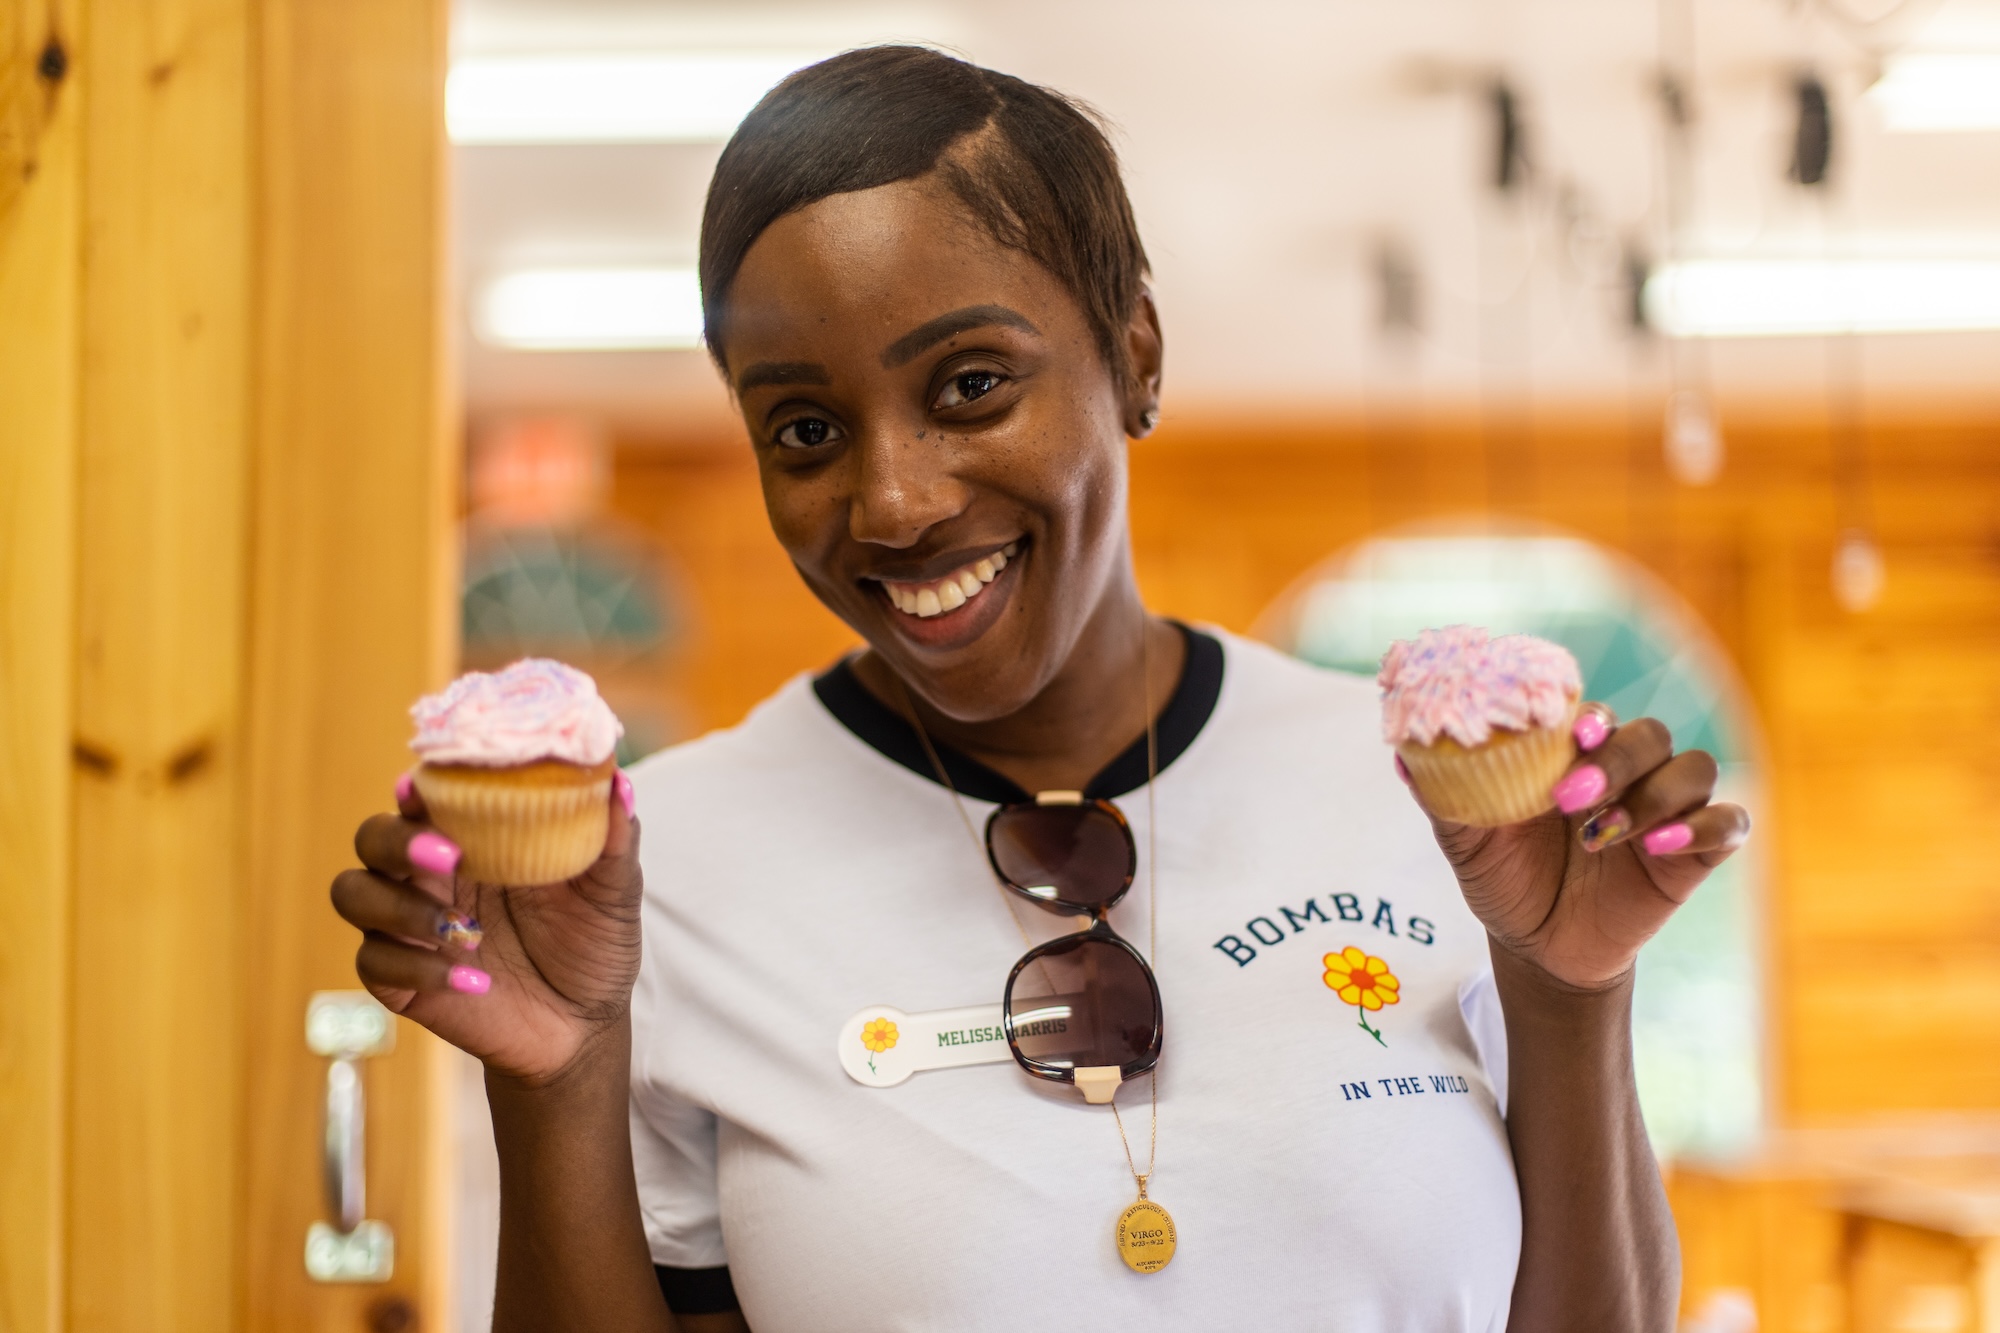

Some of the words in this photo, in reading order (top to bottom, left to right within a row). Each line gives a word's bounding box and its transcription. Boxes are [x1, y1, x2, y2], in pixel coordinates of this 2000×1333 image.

[1212, 892, 1436, 968] BOMBAS
[937, 1025, 1005, 1047] MELISSA
[1340, 1081, 1372, 1101] IN
[1378, 1076, 1425, 1097] THE
[1428, 1075, 1470, 1094] WILD
[1130, 1229, 1163, 1239] VIRGO
